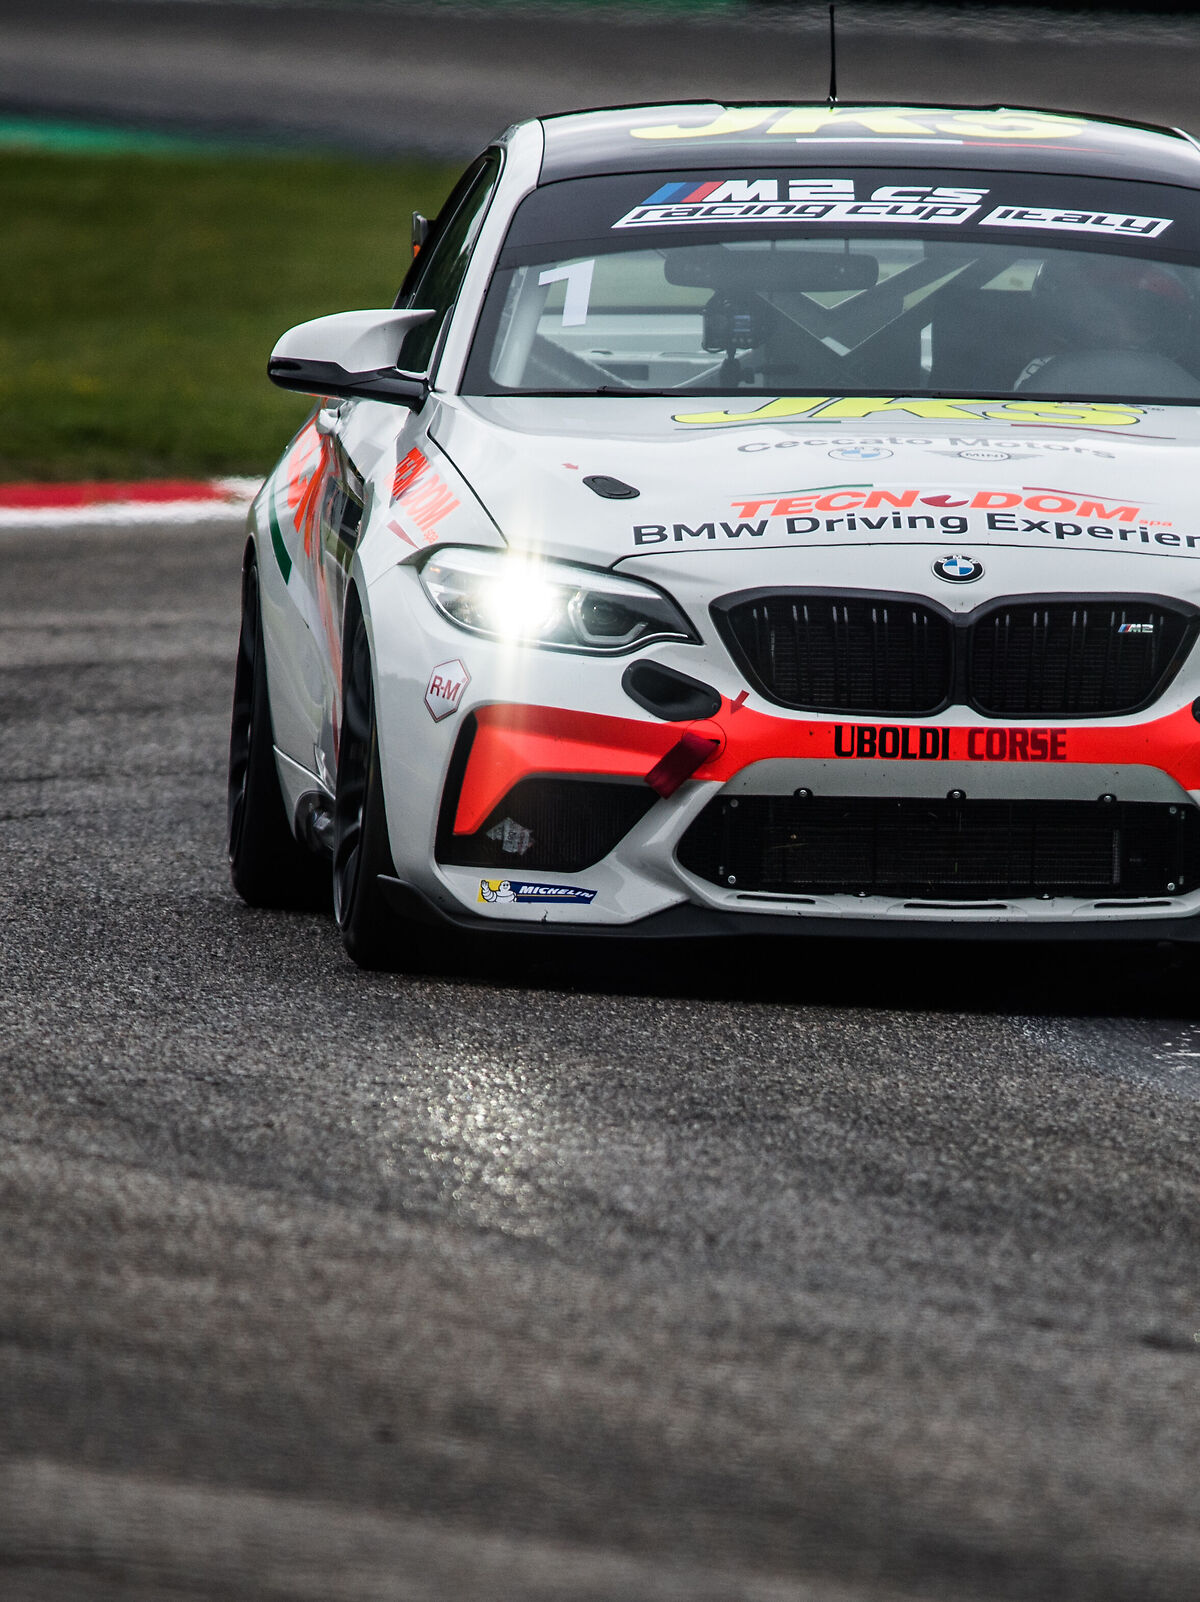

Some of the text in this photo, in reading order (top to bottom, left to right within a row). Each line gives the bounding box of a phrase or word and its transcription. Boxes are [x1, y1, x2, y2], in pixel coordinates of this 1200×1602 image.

[538, 259, 595, 327] 1
[671, 397, 1148, 425] JKS
[737, 437, 1116, 459] Ceccato Motors
[632, 518, 769, 547] BMW
[786, 512, 969, 535] Driving
[834, 726, 1067, 761] UBOLDI CORSE
[519, 885, 595, 899] MICHELIN
